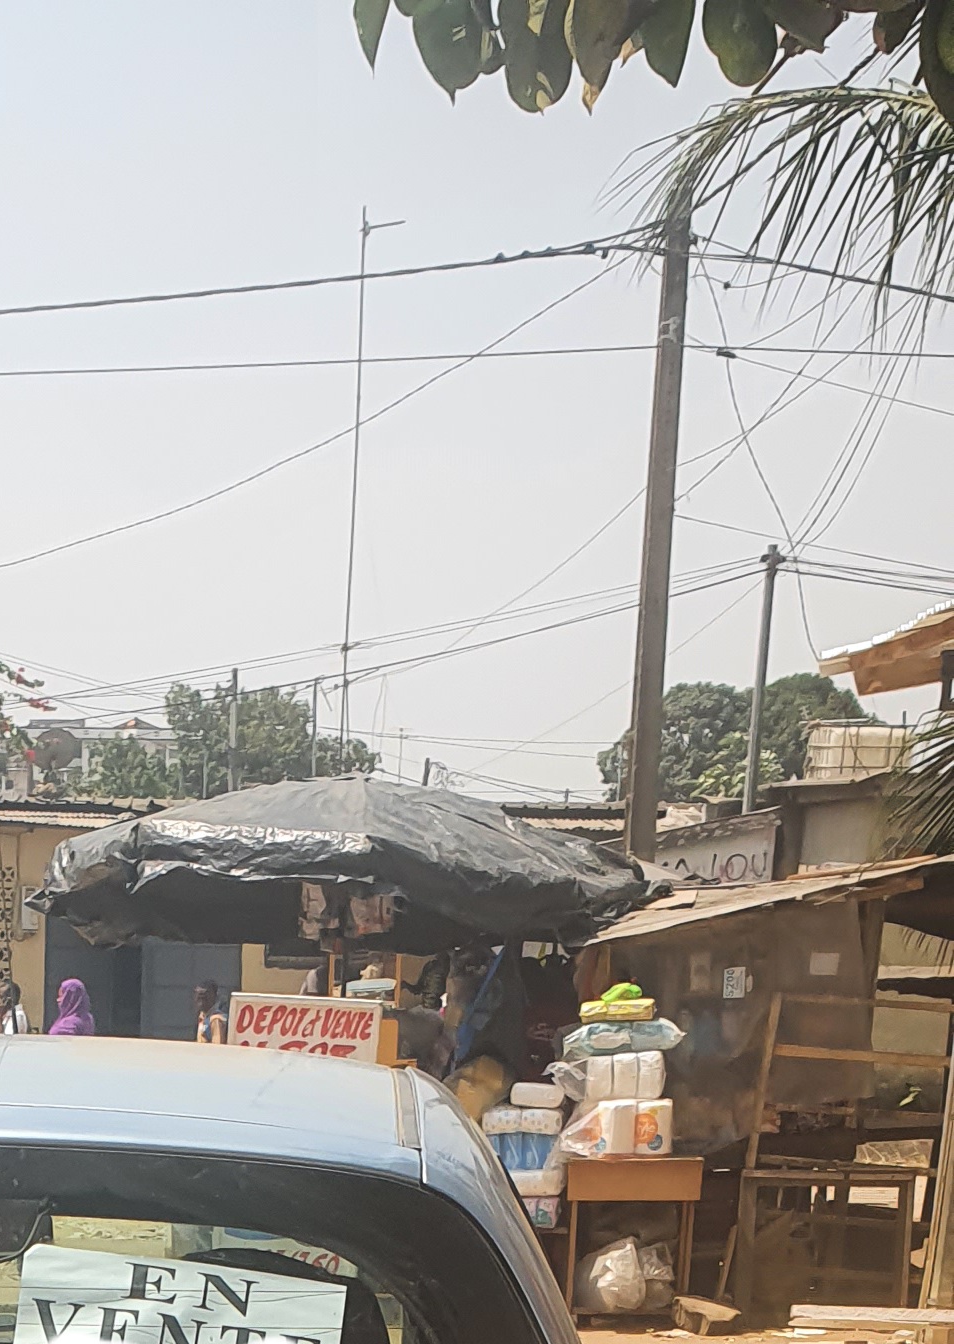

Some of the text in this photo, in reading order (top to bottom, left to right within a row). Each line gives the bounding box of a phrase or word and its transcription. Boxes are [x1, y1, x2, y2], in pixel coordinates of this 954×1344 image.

[236, 1004, 310, 1037] DEPOT
[320, 1007, 374, 1041] VENTE
[121, 1261, 259, 1318] EN
